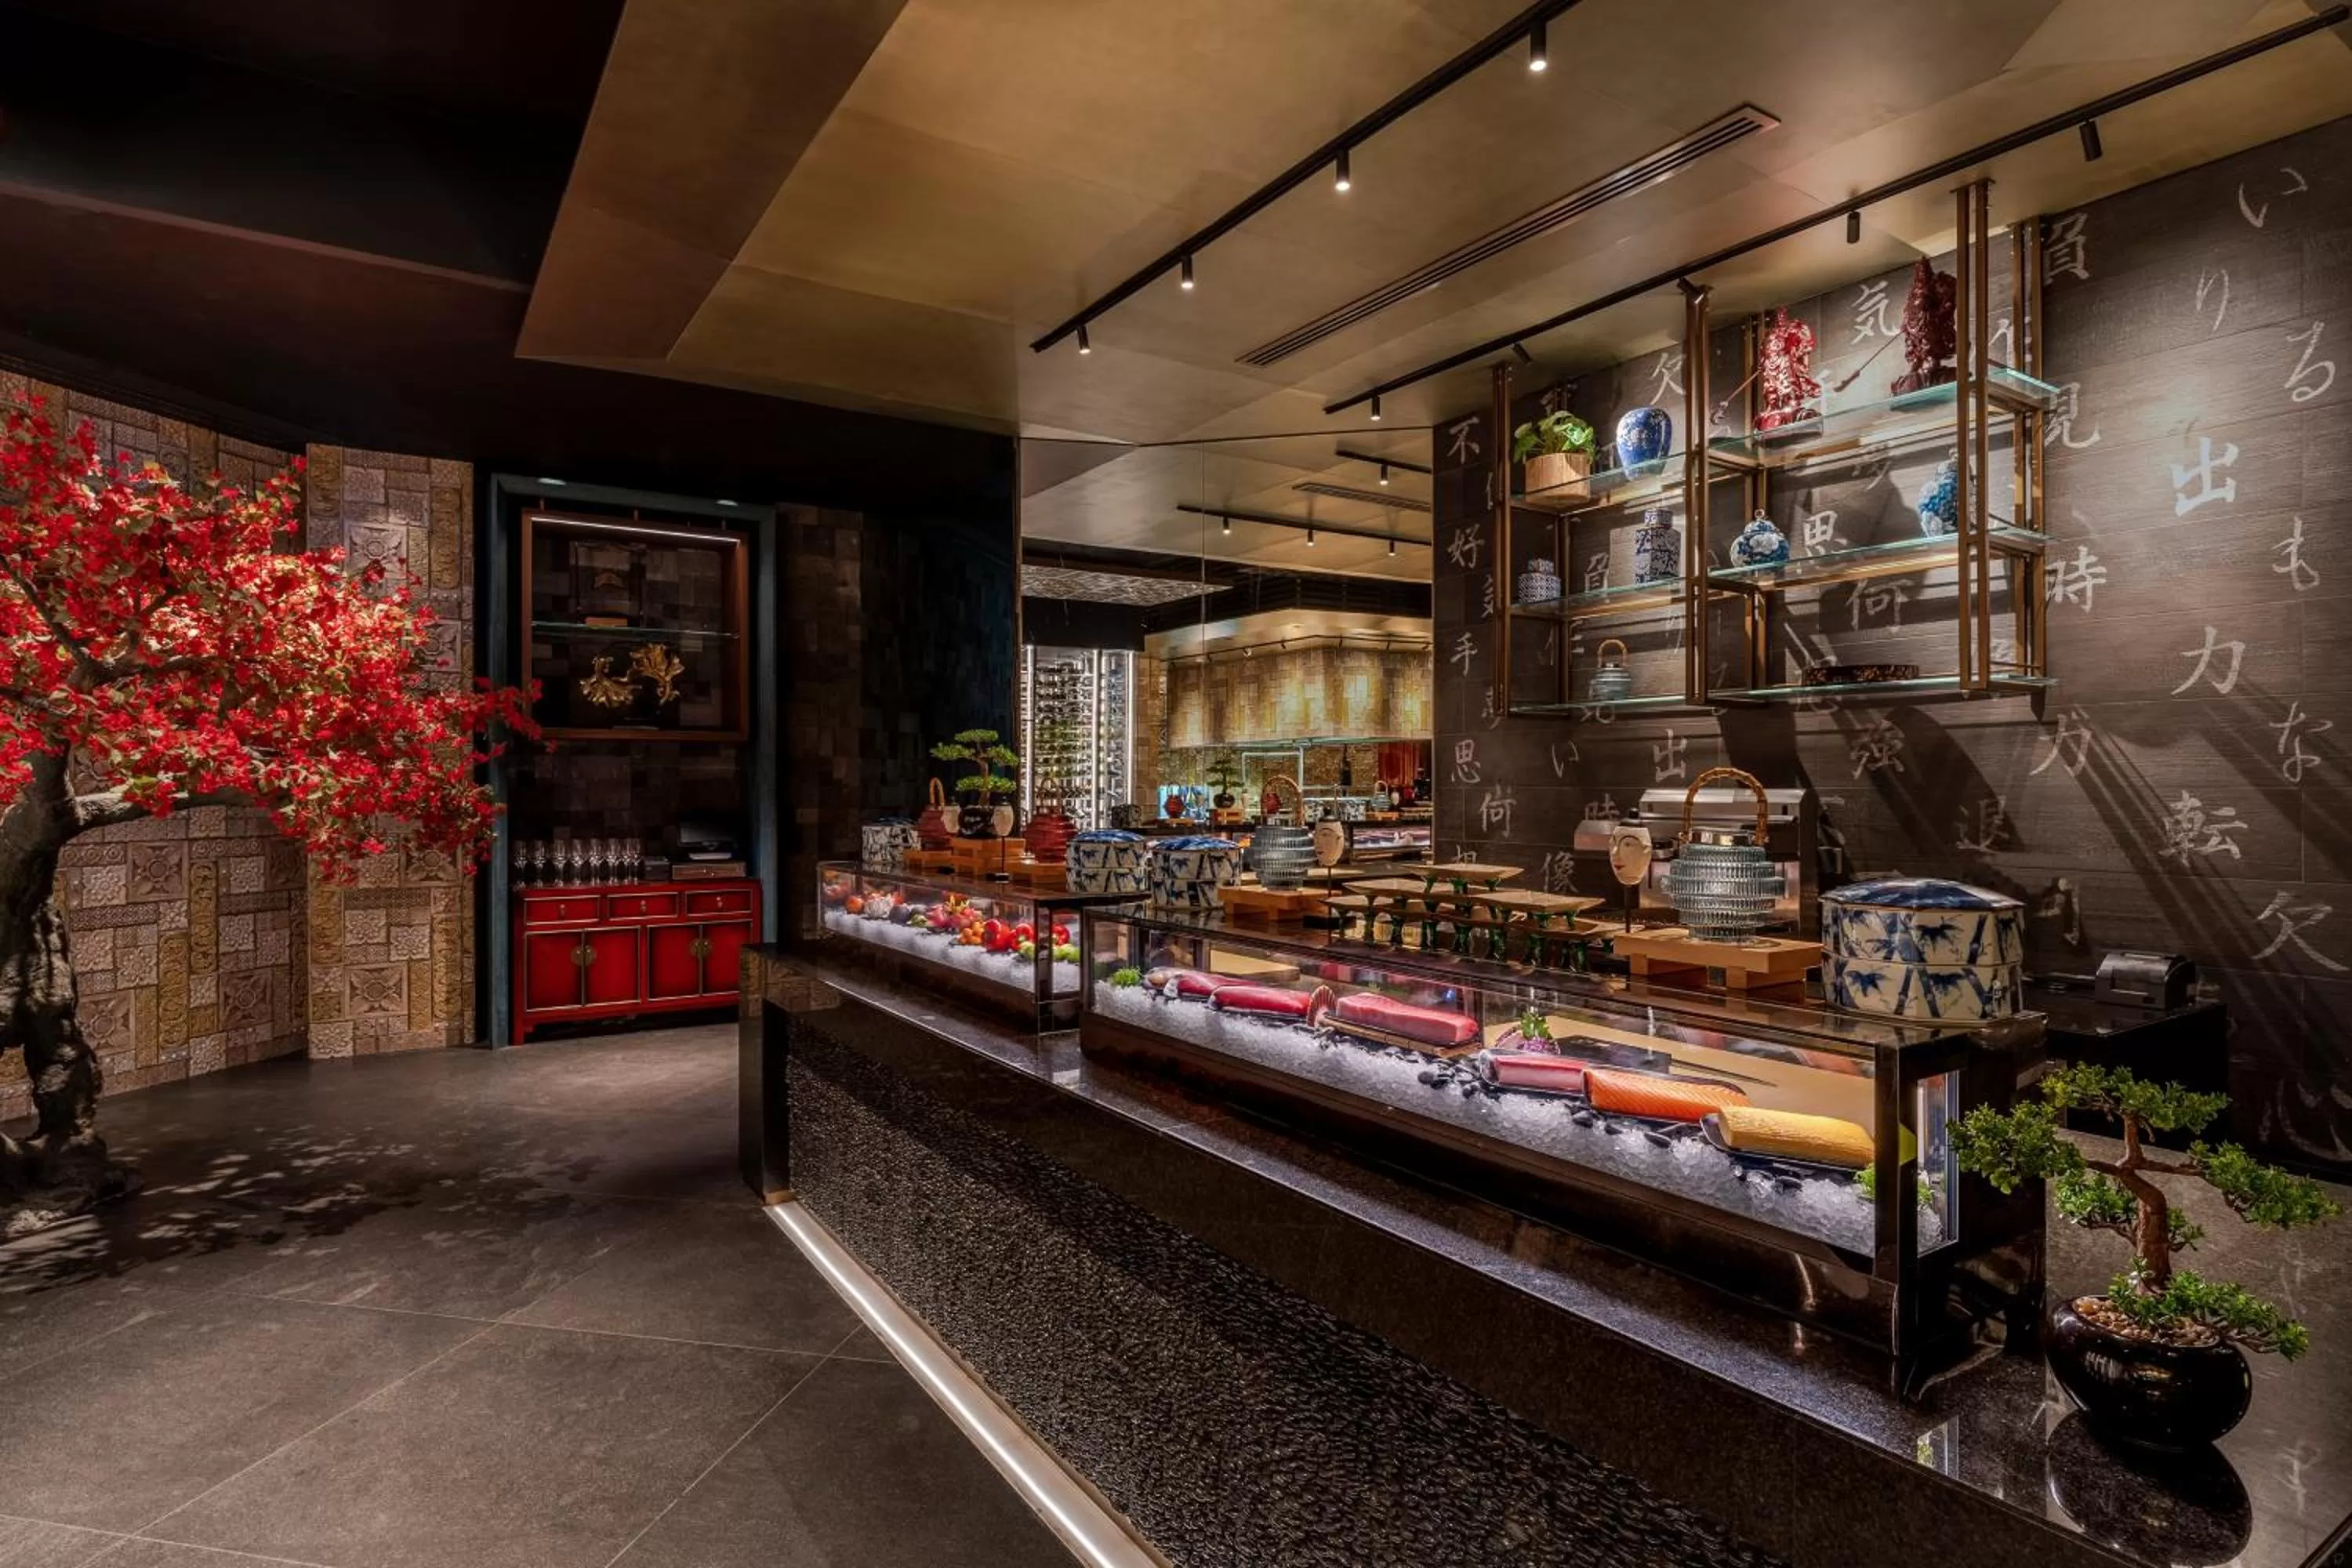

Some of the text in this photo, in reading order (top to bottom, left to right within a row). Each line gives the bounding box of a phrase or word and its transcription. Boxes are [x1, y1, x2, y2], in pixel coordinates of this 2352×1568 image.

[2238, 167, 2309, 228] い
[1851, 281, 1905, 345] 気
[2195, 268, 2230, 332] り
[2285, 320, 2336, 402] る
[1448, 416, 1480, 464] 不
[2173, 437, 2240, 517] 出
[1447, 523, 1485, 568] 好
[1846, 578, 1910, 633] 何
[1451, 633, 1478, 677] 手
[2171, 626, 2246, 695] 力
[1451, 739, 1481, 784] 思
[1653, 728, 1687, 782] 出
[2269, 702, 2333, 783] な
[1479, 788, 1517, 838] 何
